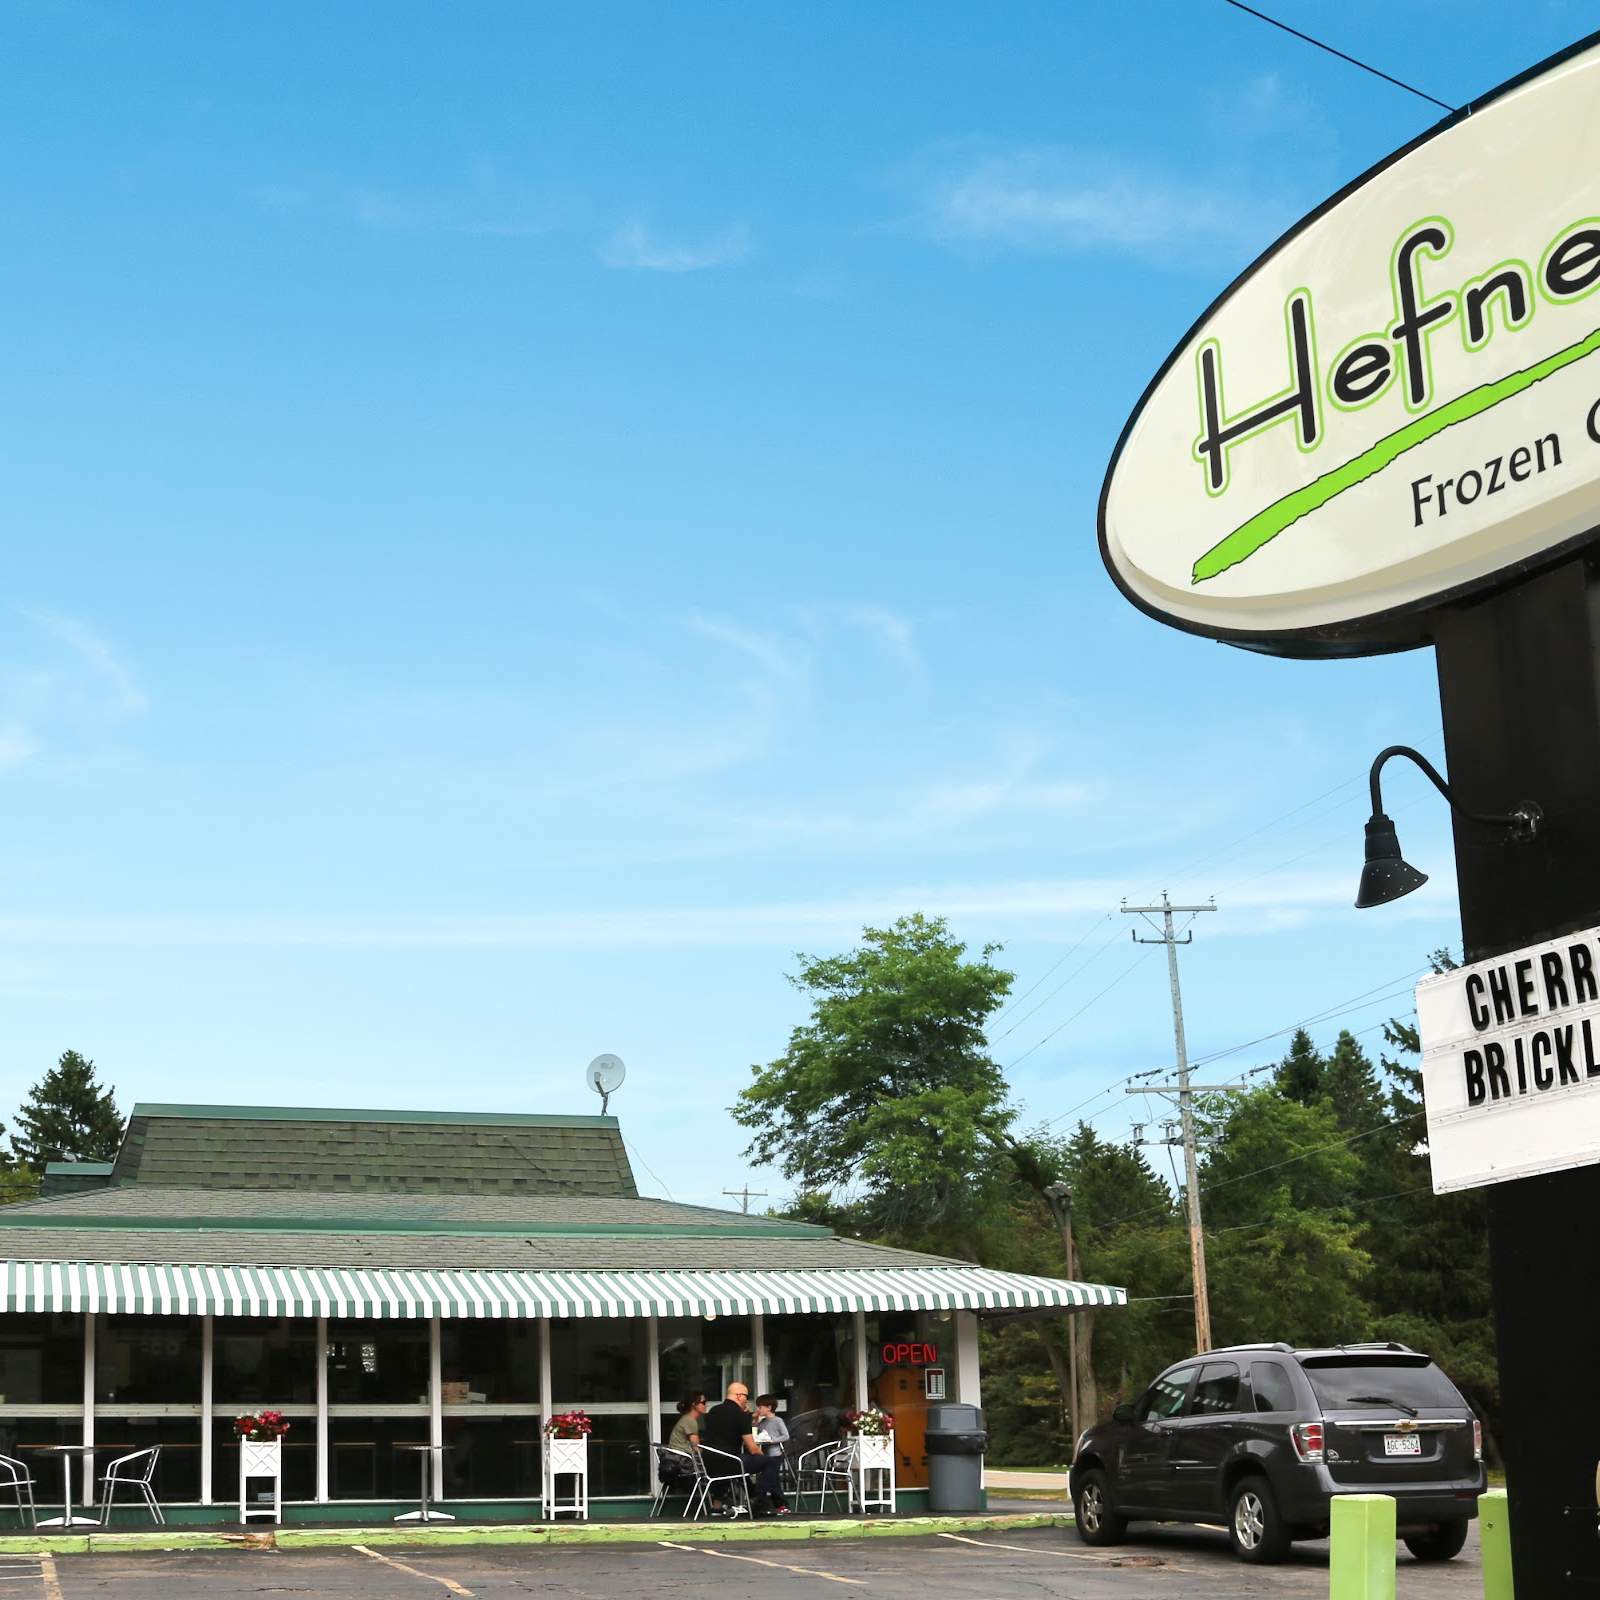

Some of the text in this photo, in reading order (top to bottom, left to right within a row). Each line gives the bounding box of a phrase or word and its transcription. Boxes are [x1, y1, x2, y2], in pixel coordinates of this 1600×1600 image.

[1198, 227, 1600, 489] Hefne
[1412, 432, 1562, 527] Frozen
[1465, 936, 1600, 1032] CHERR
[1463, 1019, 1600, 1107] BRICKL
[882, 1343, 938, 1364] OPEN
